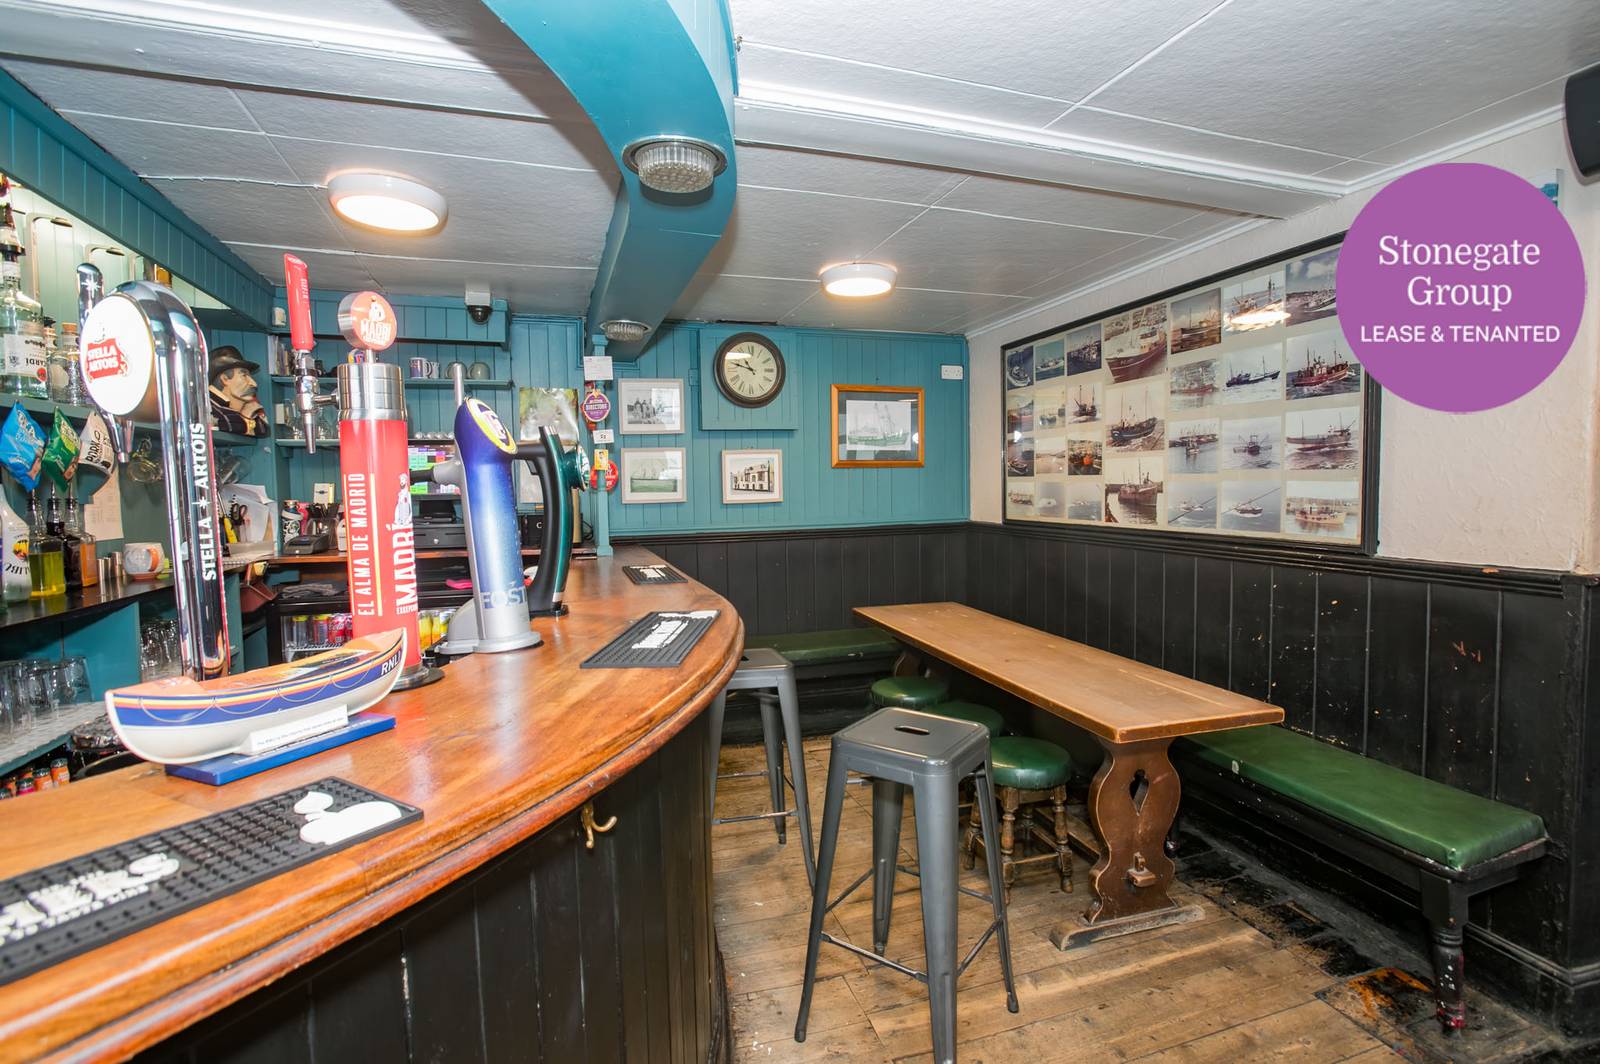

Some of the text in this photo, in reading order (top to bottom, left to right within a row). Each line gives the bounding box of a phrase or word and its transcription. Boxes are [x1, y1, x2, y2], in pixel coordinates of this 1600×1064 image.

[87, 345, 118, 361] STELLA
[88, 356, 119, 373] ARTOIS
[189, 423, 217, 582] STELLA ARTOIS
[347, 472, 375, 617] EL ALMA DE MADRID
